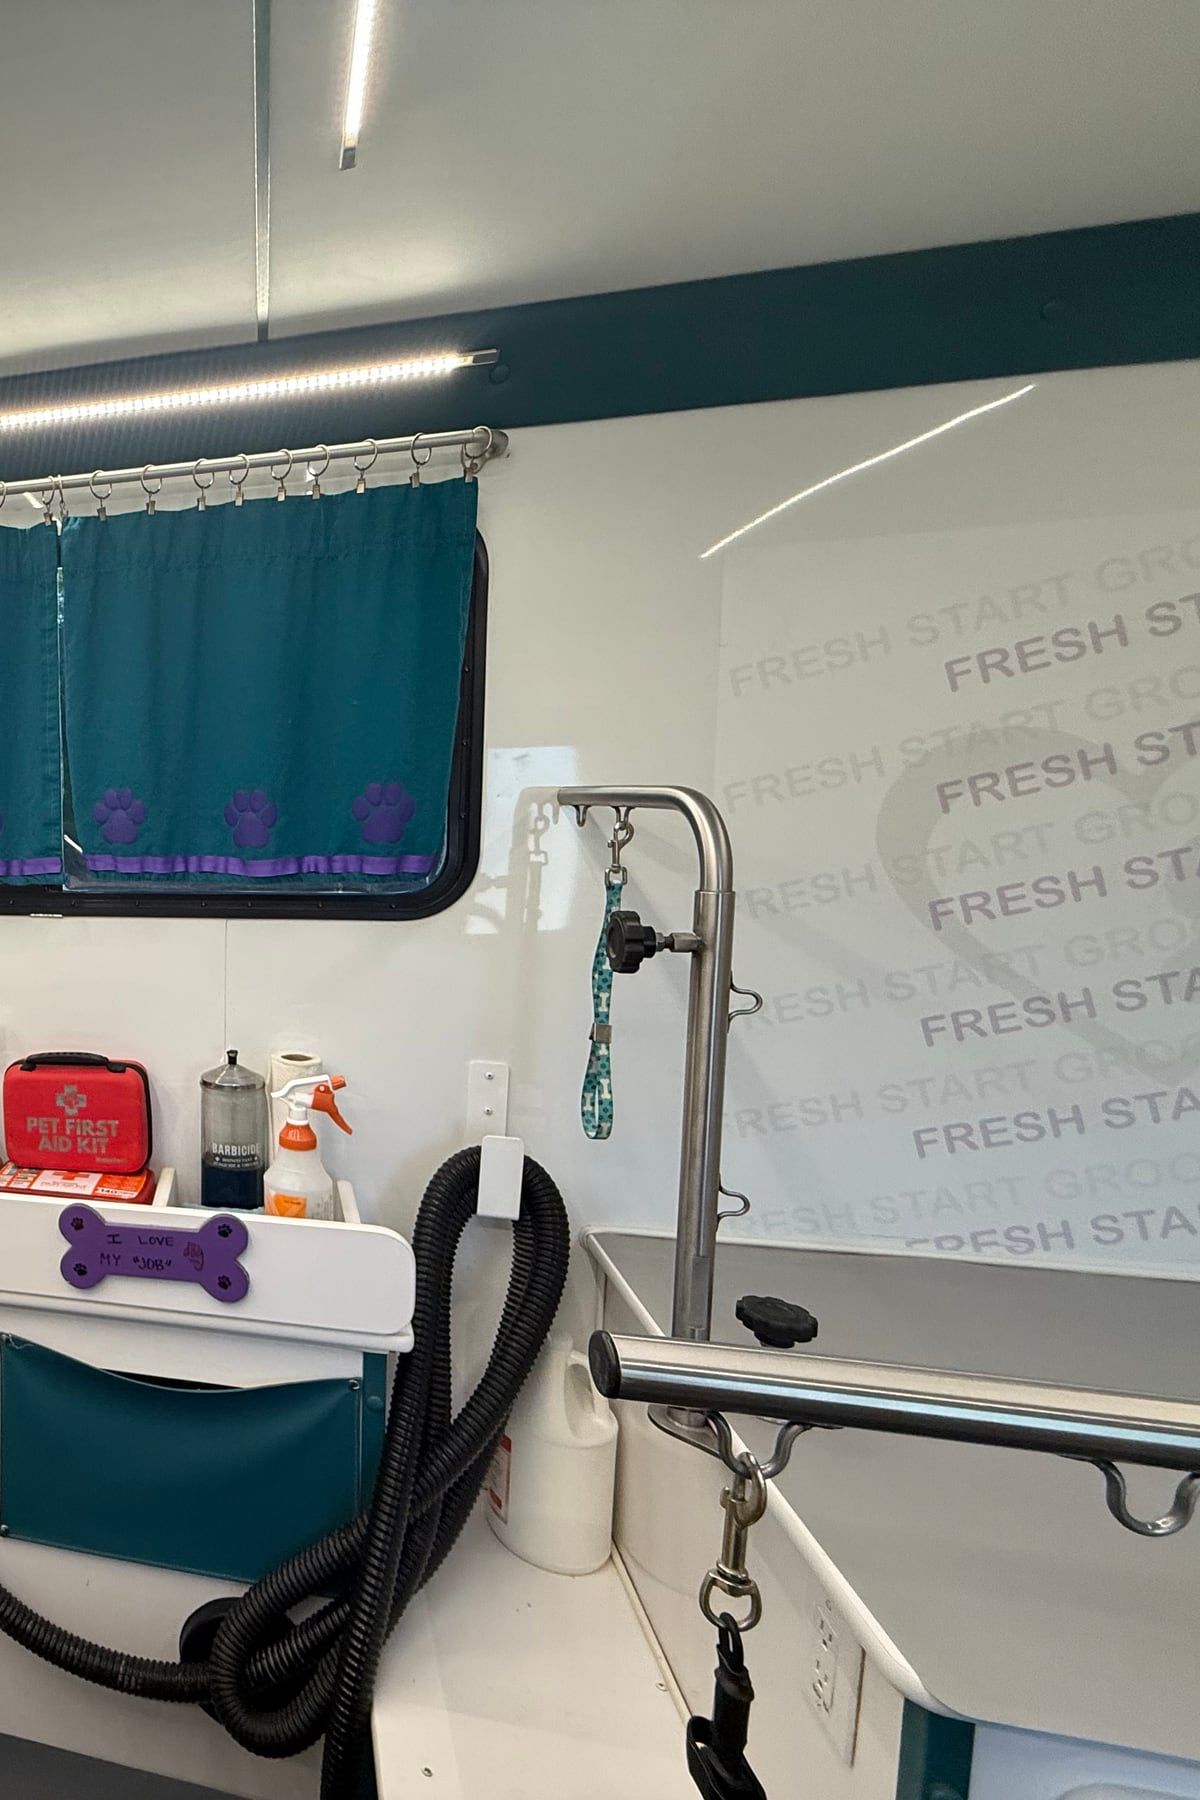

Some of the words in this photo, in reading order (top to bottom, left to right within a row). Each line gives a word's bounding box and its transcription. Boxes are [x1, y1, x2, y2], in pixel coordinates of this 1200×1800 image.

[729, 624, 891, 696] FRESH
[906, 572, 1073, 646] START
[943, 614, 1128, 692] FRESH
[722, 746, 885, 815] FRESH
[900, 700, 1068, 769] START
[936, 743, 1117, 814] FRESH
[737, 860, 879, 919] RESH
[888, 823, 1057, 884] START
[928, 866, 1107, 931] FRESH
[1123, 846, 1200, 891] ST
[920, 987, 1097, 1047] FRESH
[26, 1117, 59, 1134] PET
[725, 1089, 864, 1138] RESH
[878, 1058, 1037, 1115] START
[39, 1136, 72, 1153] AID
[77, 1137, 109, 1154] KIT
[212, 1141, 261, 1156] BARBICIDE
[912, 1104, 1086, 1159] FRESH
[873, 1175, 1025, 1224] START
[1090, 1205, 1200, 1245] STA
[100, 1252, 121, 1266] MY
[133, 1255, 172, 1271] "JOB"
[107, 1233, 122, 1245] I
[138, 1235, 175, 1247] LOVE
